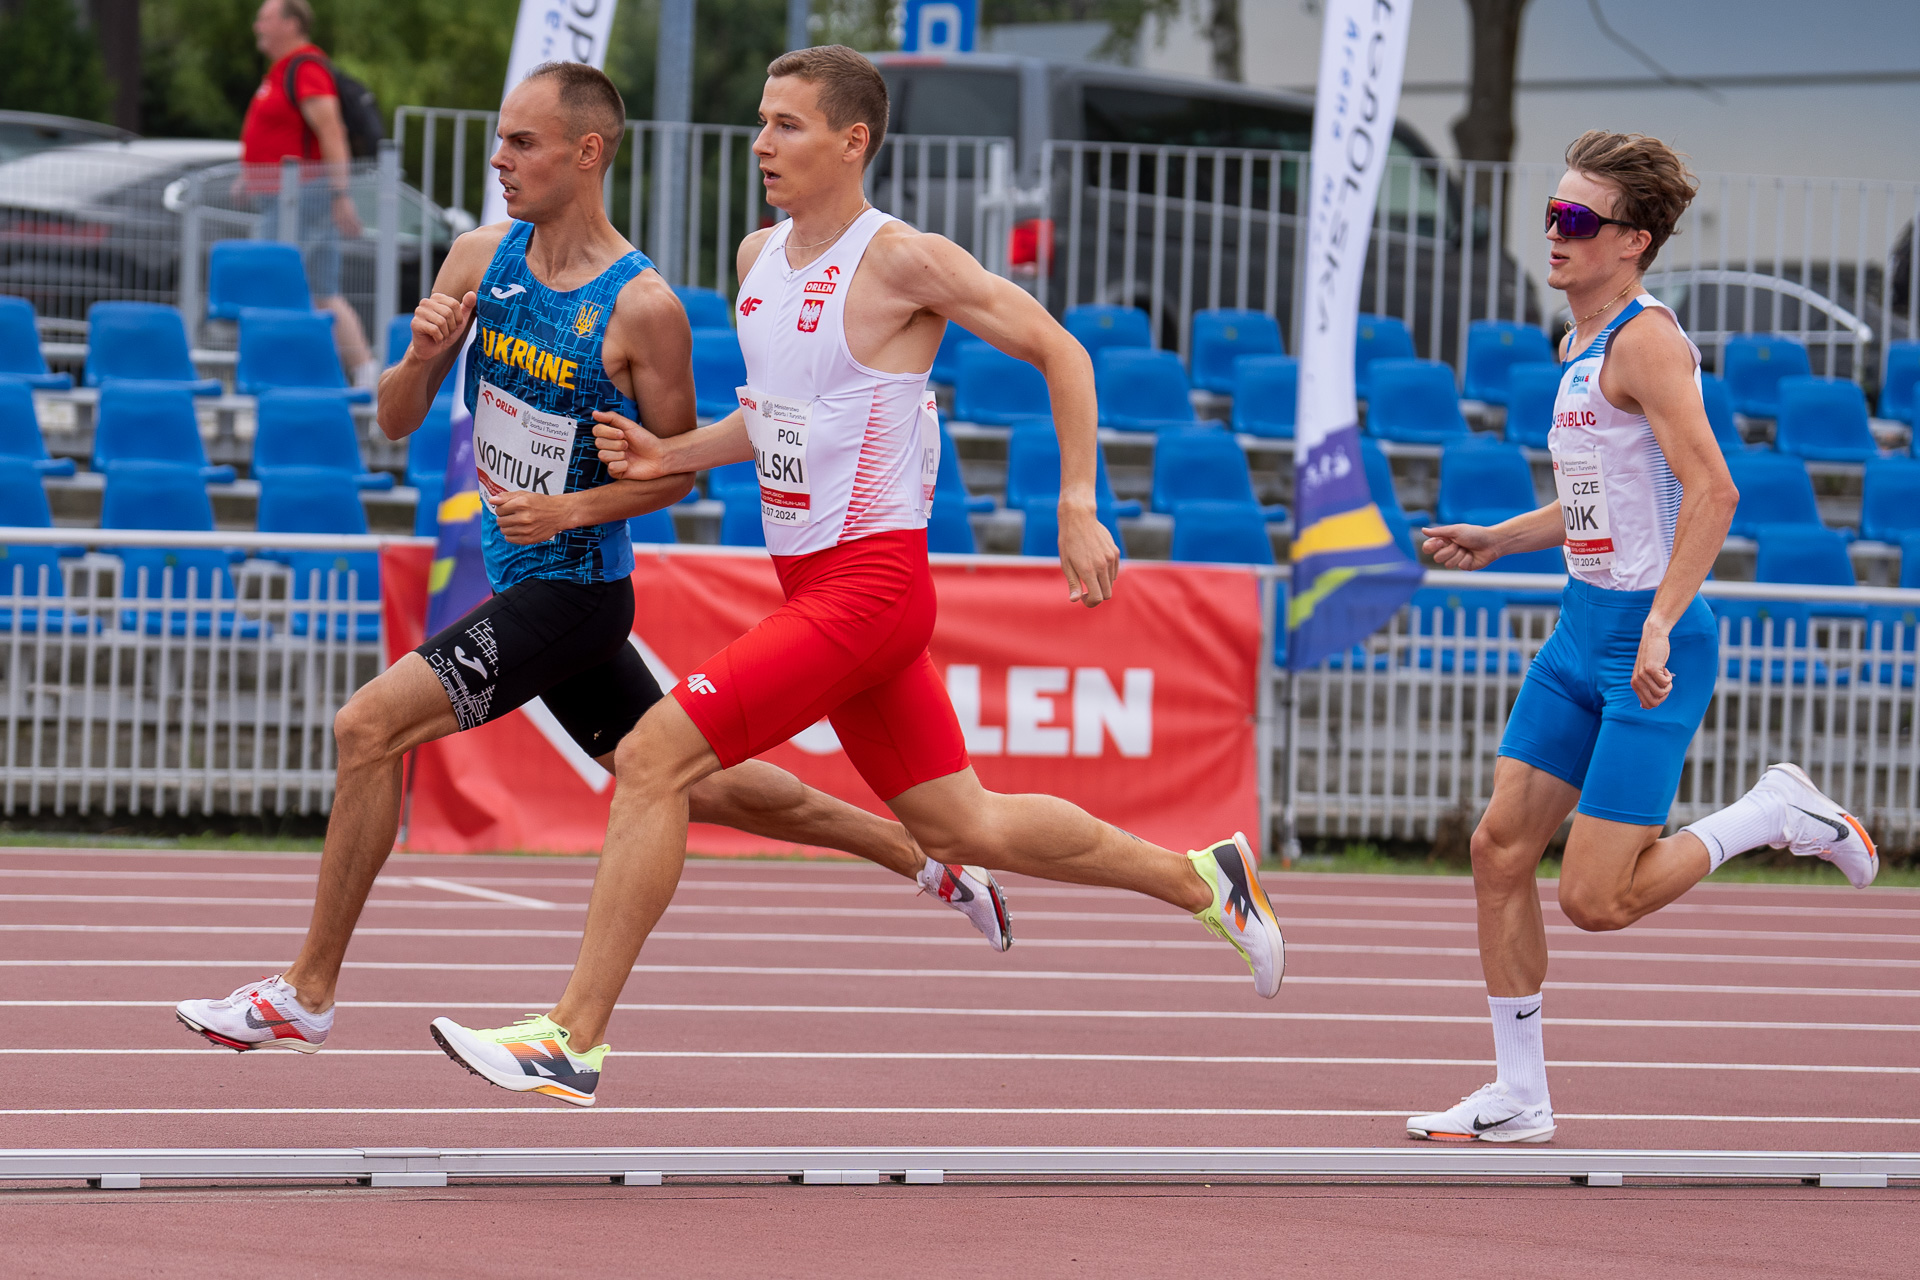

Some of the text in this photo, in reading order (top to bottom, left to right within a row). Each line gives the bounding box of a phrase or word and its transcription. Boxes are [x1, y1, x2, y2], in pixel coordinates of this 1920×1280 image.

[805, 282, 835, 294] ORLEN
[739, 296, 763, 317] 4F
[482, 327, 578, 390] UKRAINE
[495, 398, 518, 418] ORLEN
[531, 415, 560, 428] Ministerstwo
[546, 427, 569, 437] Turystyki
[778, 429, 803, 446] POL
[531, 440, 566, 461] UKR
[477, 436, 554, 496] VOITIUK
[1572, 481, 1600, 495] CZE
[686, 673, 717, 696] 4F
